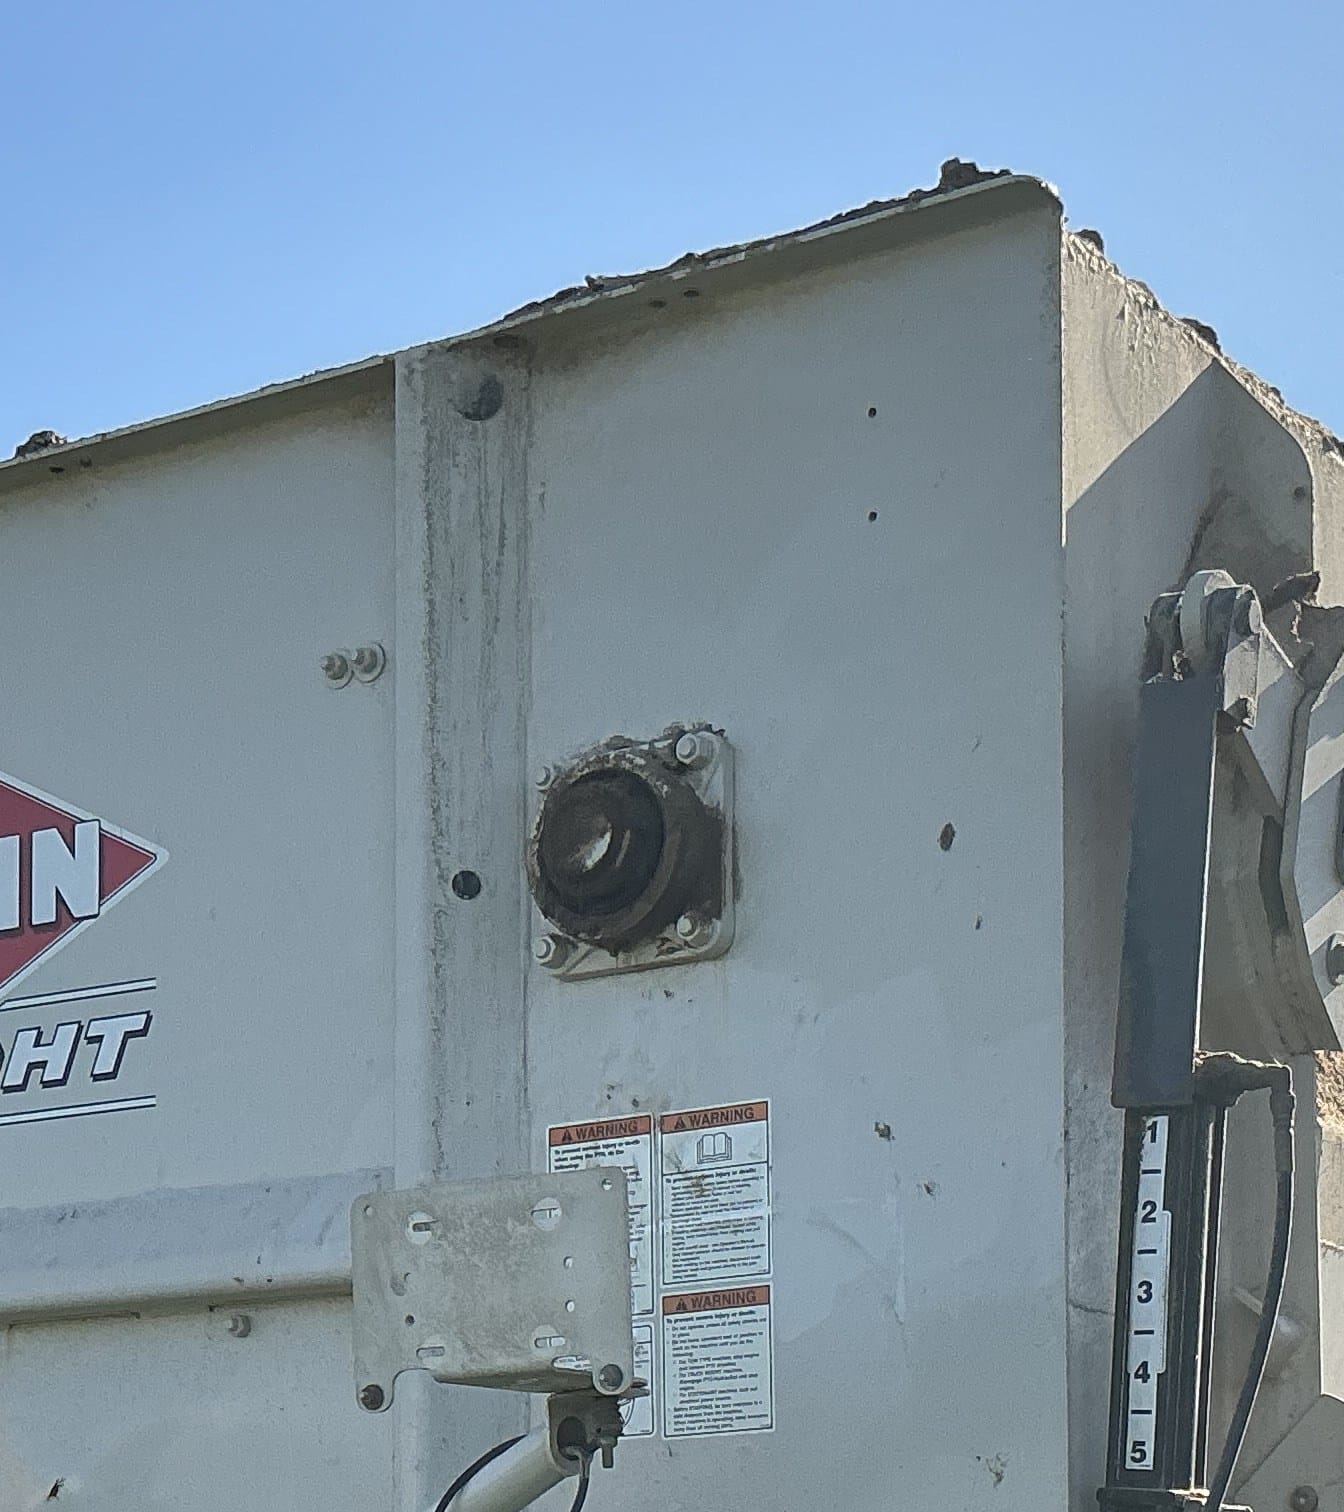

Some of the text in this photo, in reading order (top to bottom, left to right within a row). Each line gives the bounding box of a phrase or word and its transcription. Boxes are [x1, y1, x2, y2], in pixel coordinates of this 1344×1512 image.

[688, 1107, 754, 1128] WARNING
[576, 1120, 638, 1140] WARNING
[1145, 1120, 1157, 1144] 1
[1141, 1200, 1157, 1223] 2
[690, 1290, 756, 1309] WARNING
[1137, 1280, 1153, 1304] 3
[1134, 1361, 1151, 1384] 4
[1130, 1440, 1147, 1463] 5
